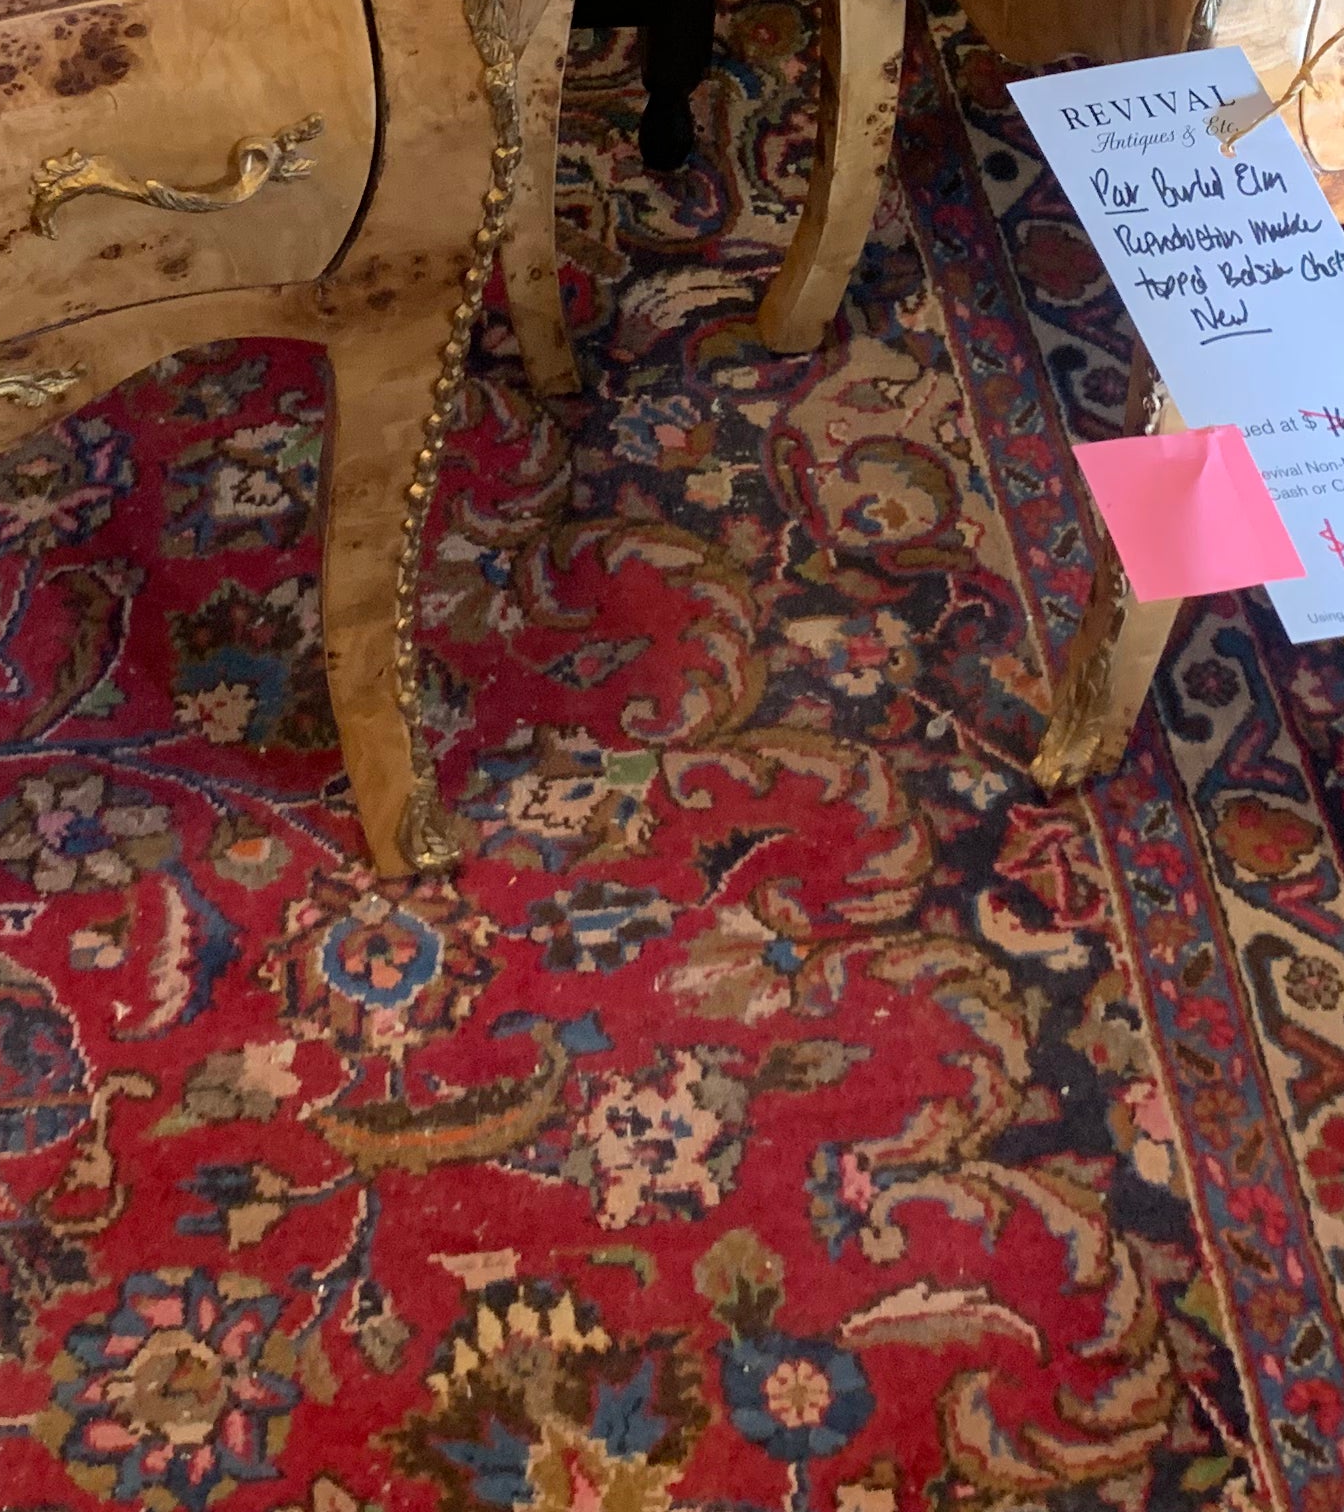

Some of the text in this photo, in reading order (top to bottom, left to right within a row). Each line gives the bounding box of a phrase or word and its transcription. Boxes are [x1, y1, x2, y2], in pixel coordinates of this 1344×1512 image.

[1061, 85, 1236, 131] REVIVAL
[1091, 114, 1239, 156] Antiques & Etc.
[1090, 167, 1141, 208] Pair
[1235, 162, 1287, 196] Elm
[1191, 296, 1249, 331] New
[1242, 418, 1276, 438] ued
[1280, 417, 1297, 434] at
[1261, 462, 1304, 482] evival
[1269, 485, 1309, 502] Cash
[1312, 482, 1328, 495] or
